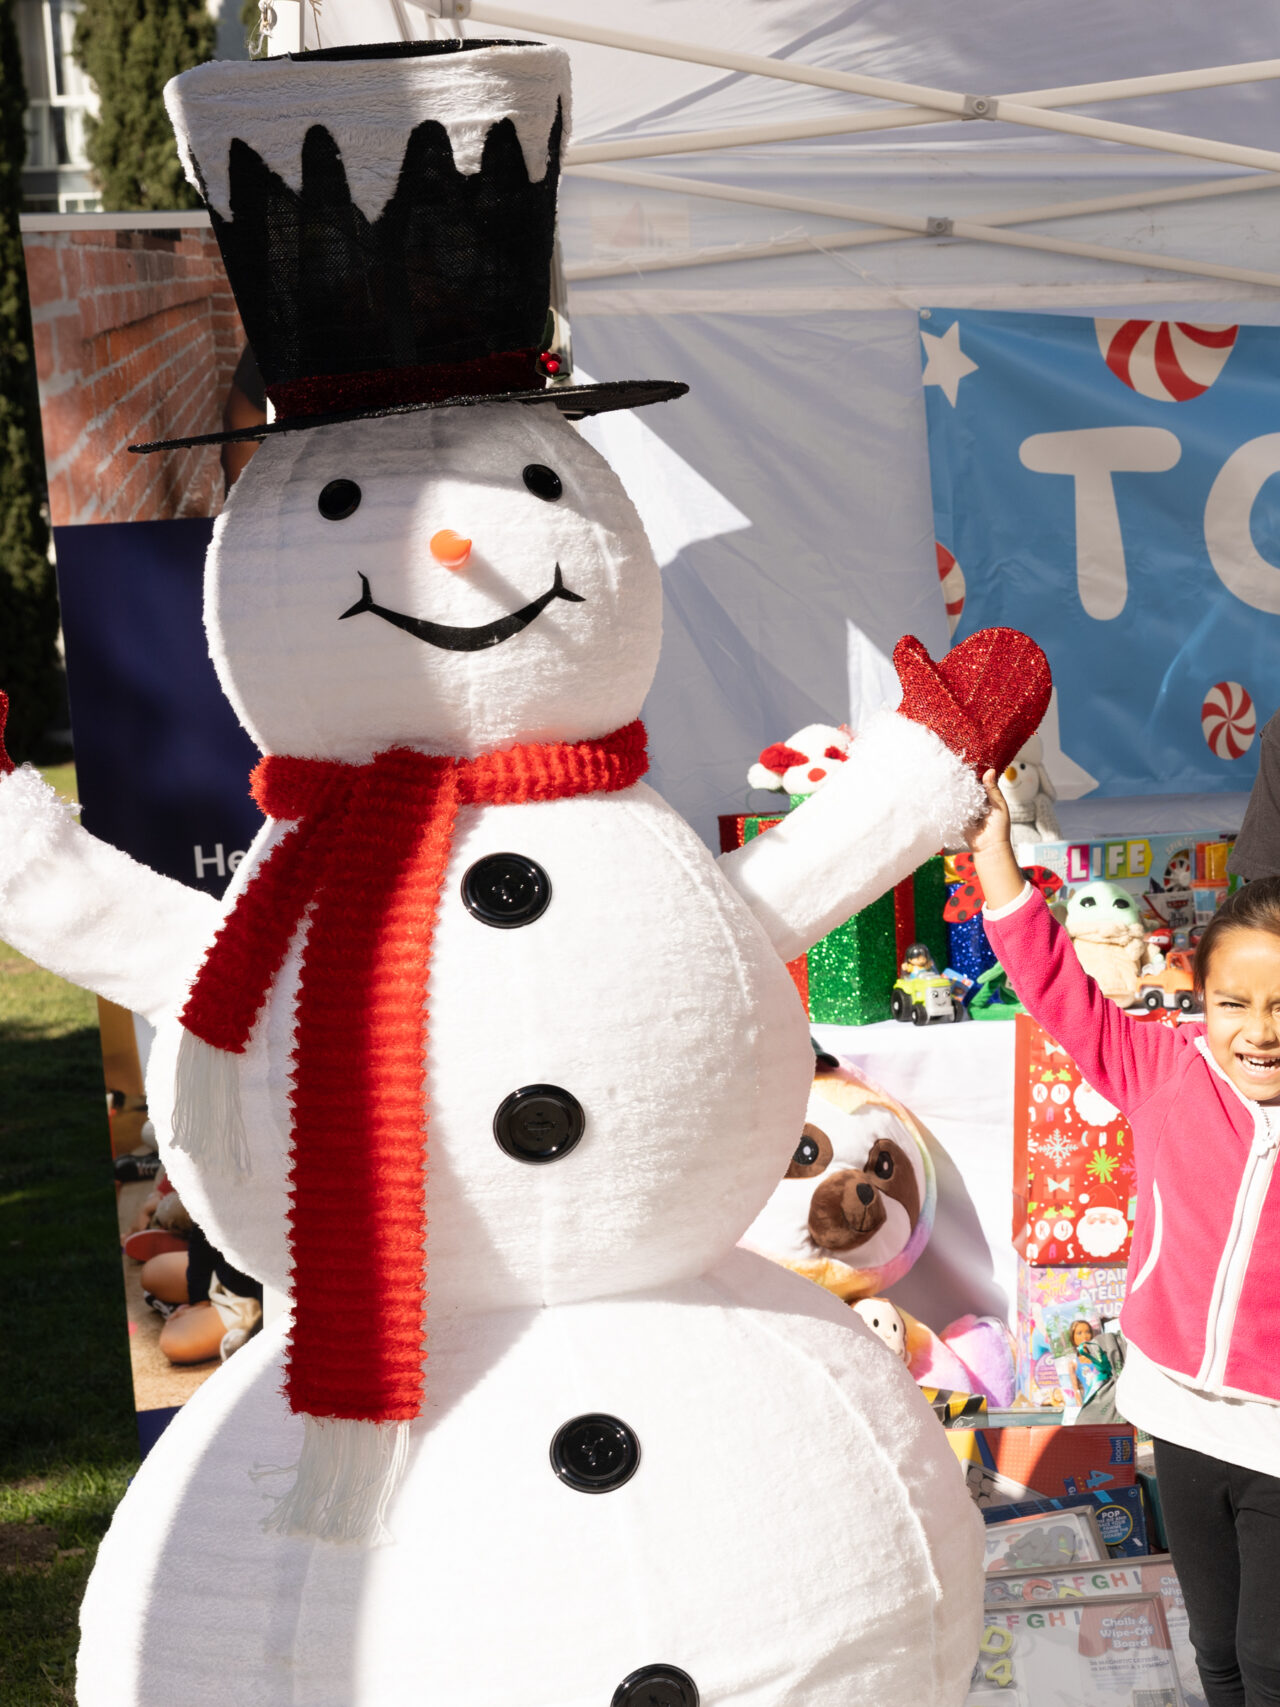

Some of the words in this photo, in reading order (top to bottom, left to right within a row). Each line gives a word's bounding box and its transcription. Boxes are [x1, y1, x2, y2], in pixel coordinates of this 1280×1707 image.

[194, 844, 246, 879] He
[1070, 842, 1146, 880] LIFE
[1101, 1510, 1121, 1519] POP
[1026, 1613, 1046, 1629] G
[1099, 1625, 1155, 1638] Wipe-Off
[1112, 1637, 1149, 1649] Board
